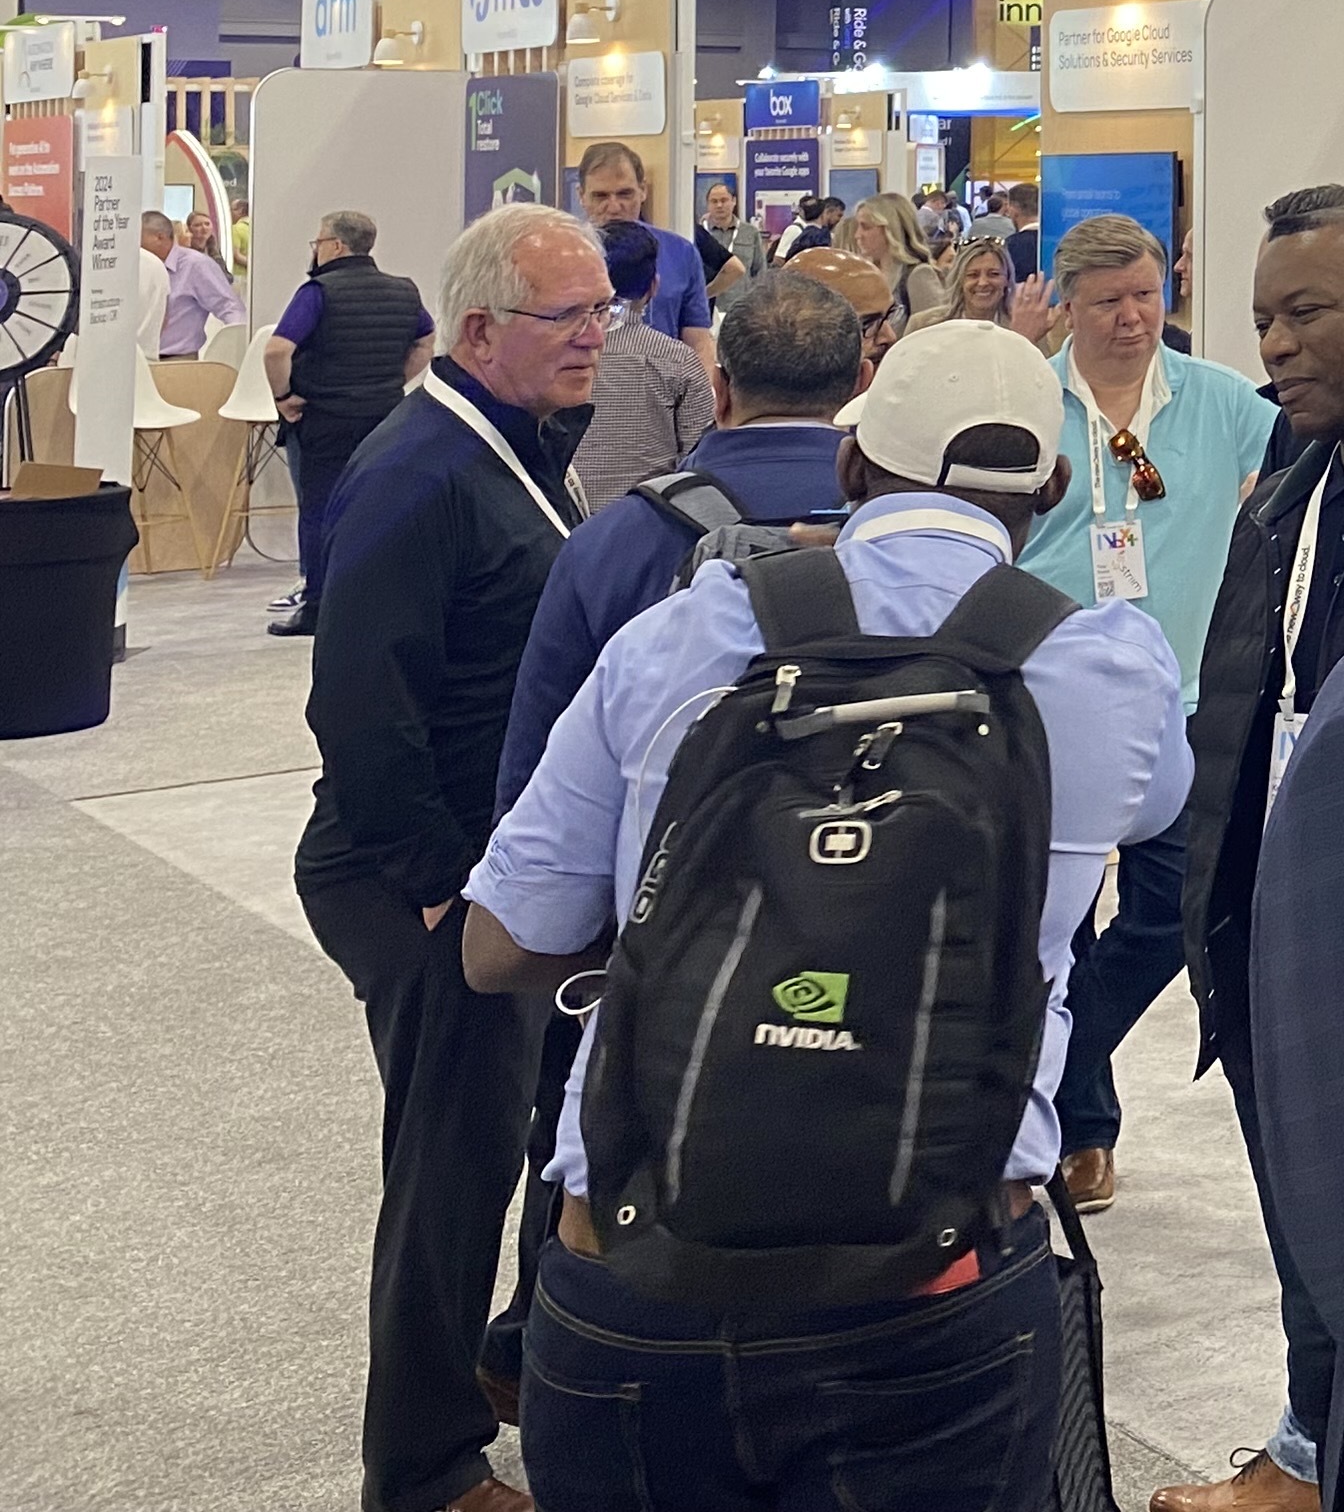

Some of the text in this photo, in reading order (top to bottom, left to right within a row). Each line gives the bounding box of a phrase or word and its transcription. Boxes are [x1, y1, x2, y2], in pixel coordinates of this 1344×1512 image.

[1058, 24, 1170, 47] Partner for Google Cloud
[1058, 48, 1193, 70] Solutions & Security Services
[477, 89, 503, 116] Click
[769, 88, 793, 116] box
[94, 194, 121, 212] Partner
